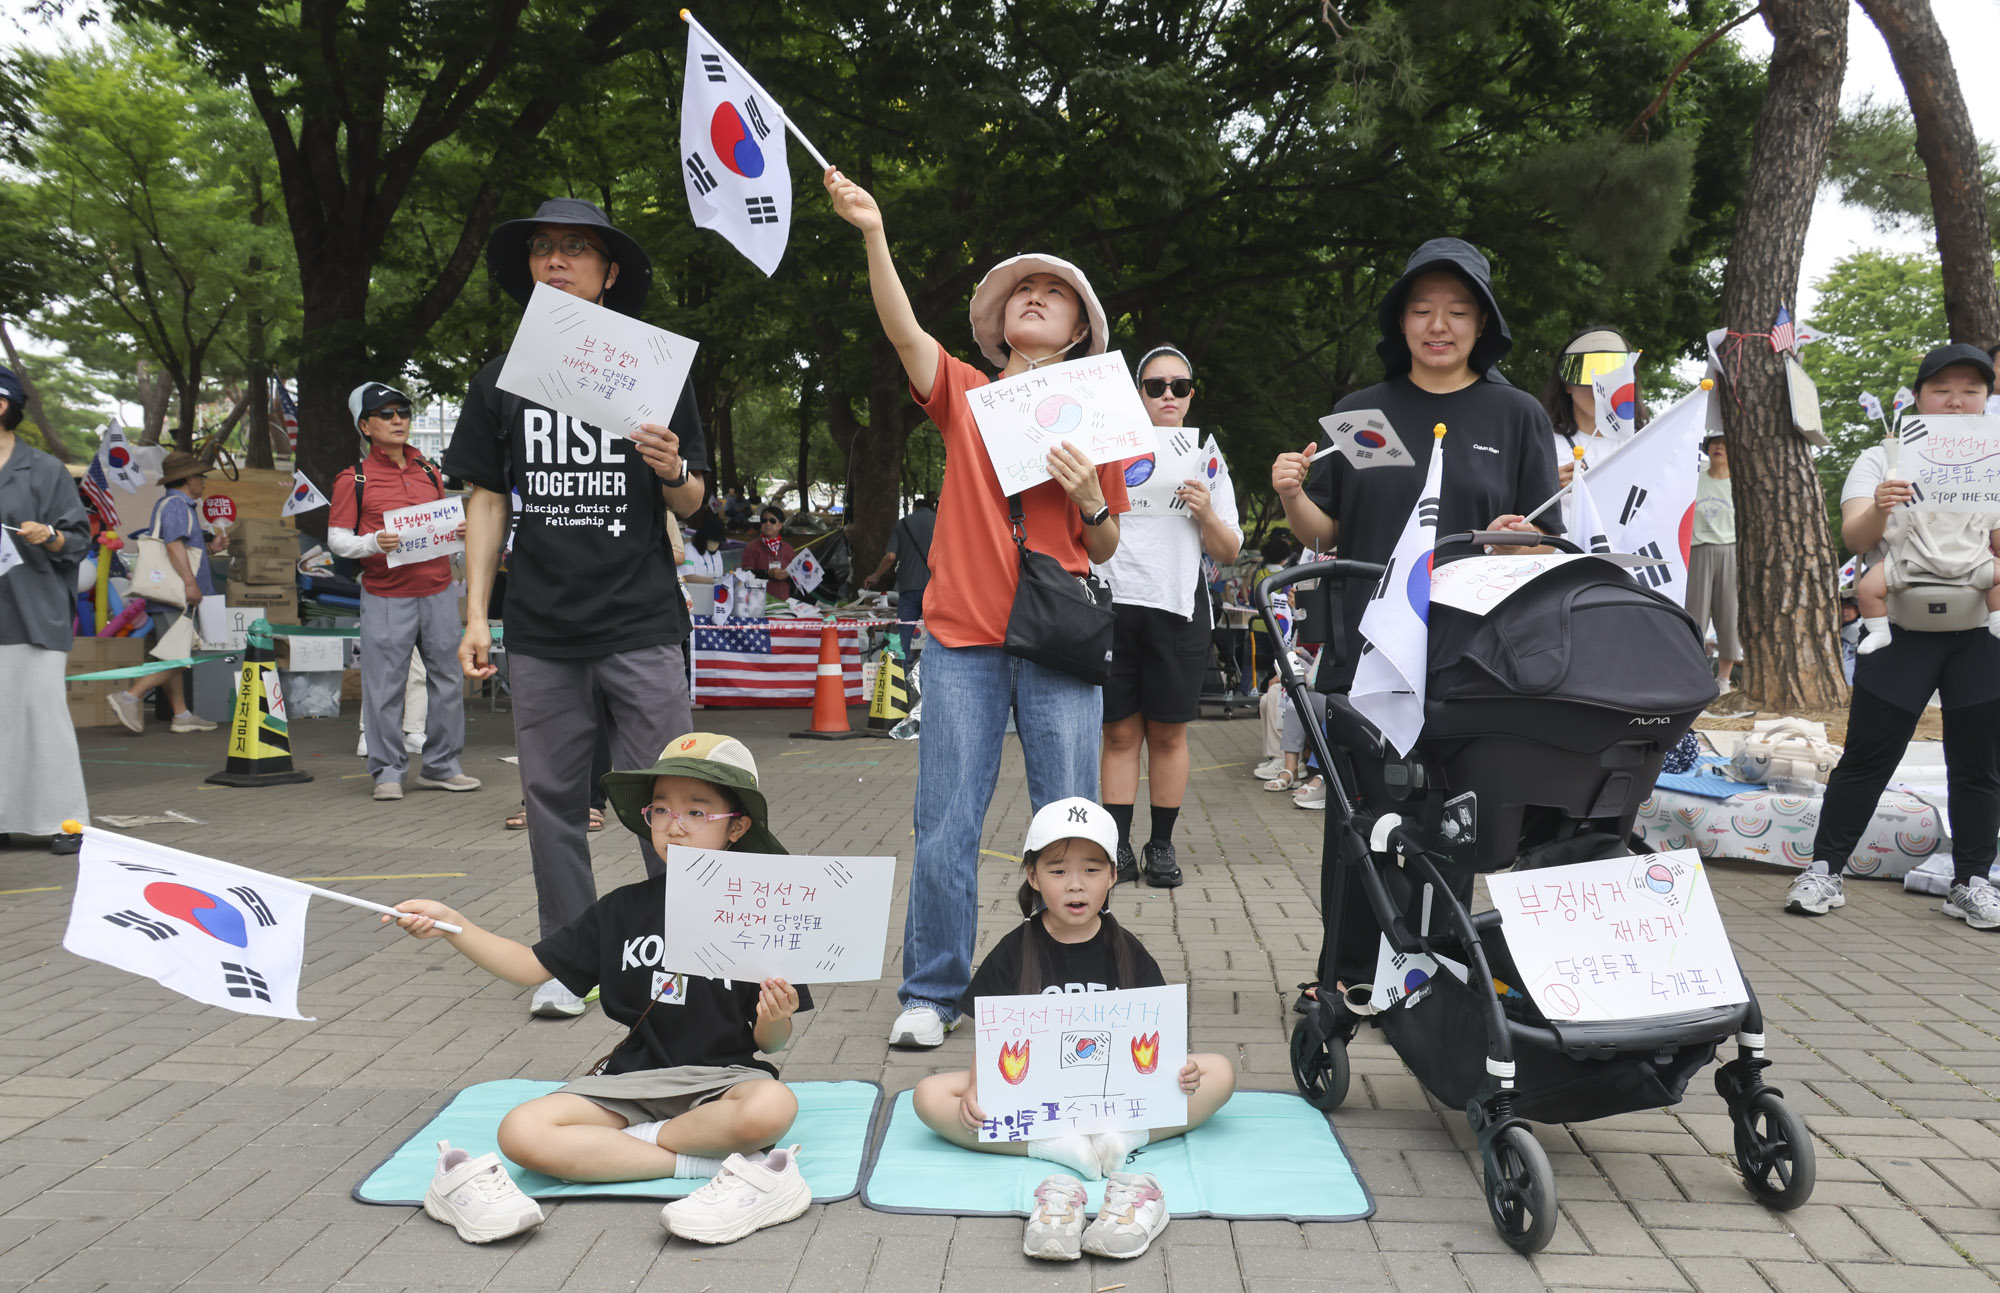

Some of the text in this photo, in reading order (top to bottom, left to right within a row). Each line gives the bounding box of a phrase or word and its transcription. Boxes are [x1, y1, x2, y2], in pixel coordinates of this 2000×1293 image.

[576, 335, 639, 368] 부정선거
[562, 355, 637, 391] 재선거 당일투표
[979, 362, 1122, 409] 부정선거 재선거
[576, 376, 616, 400] 수개표
[524, 409, 626, 465] RISE
[1090, 430, 1143, 455] 수개표
[526, 471, 626, 497] TOGETHER
[1931, 491, 2000, 503] STOP THE STE
[206, 498, 231, 507] 우리는
[207, 507, 232, 516] 하나다
[526, 504, 628, 515] Disciple Christ of
[393, 506, 458, 531] 부정선거 재선거
[545, 516, 604, 527] Fellowship
[876, 667, 886, 714] 주차금지
[236, 685, 250, 752] 주차금지
[1068, 806, 1088, 824] NY
[724, 877, 816, 908] 부정선거
[1517, 881, 1626, 926] 부정선거
[714, 910, 823, 931] 재선거 당일투표
[1610, 914, 1688, 942] 재선거!
[731, 931, 802, 950] 수개표
[1555, 954, 1641, 985] 당일투표
[1650, 968, 1727, 1000] 수개표!
